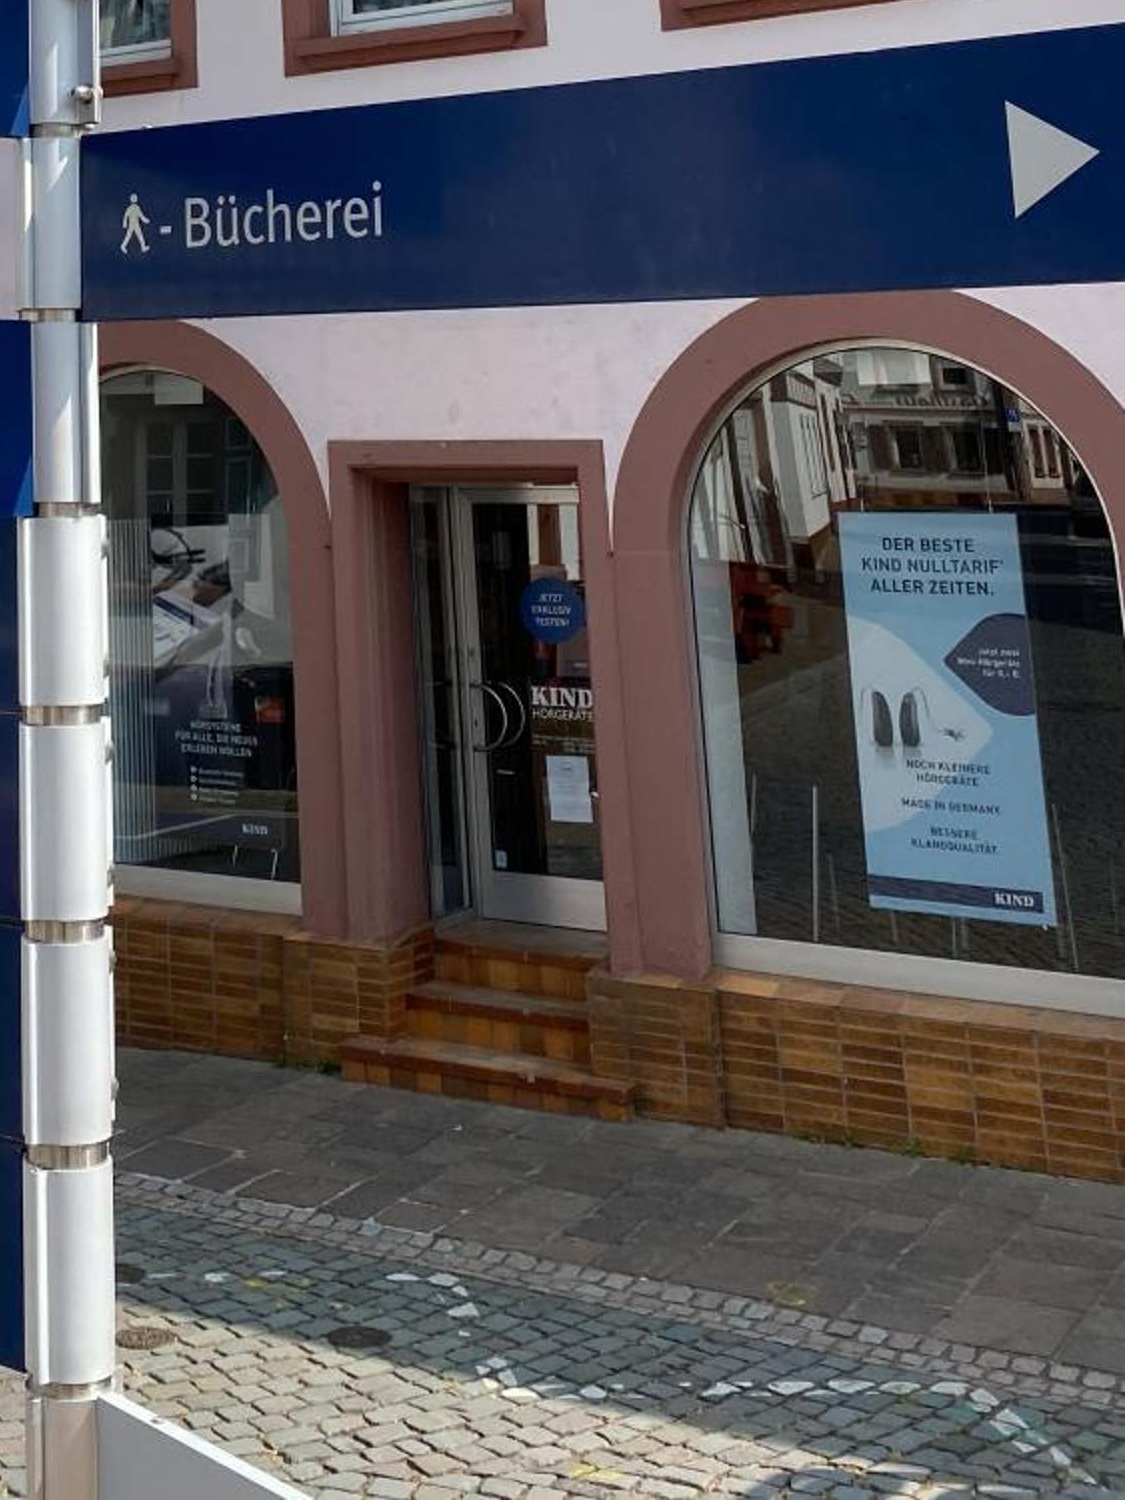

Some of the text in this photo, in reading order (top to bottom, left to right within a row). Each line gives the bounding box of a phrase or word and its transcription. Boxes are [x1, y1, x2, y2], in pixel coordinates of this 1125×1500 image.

[184, 180, 383, 248] Bücherei
[882, 536, 975, 553] DER BESTE
[861, 557, 902, 572] KIND
[870, 579, 995, 596] ALLER ZEITEN.
[530, 685, 594, 709] KIND
[901, 798, 931, 809] MADE
[935, 801, 946, 812] IN
[994, 892, 1035, 908] KIND
